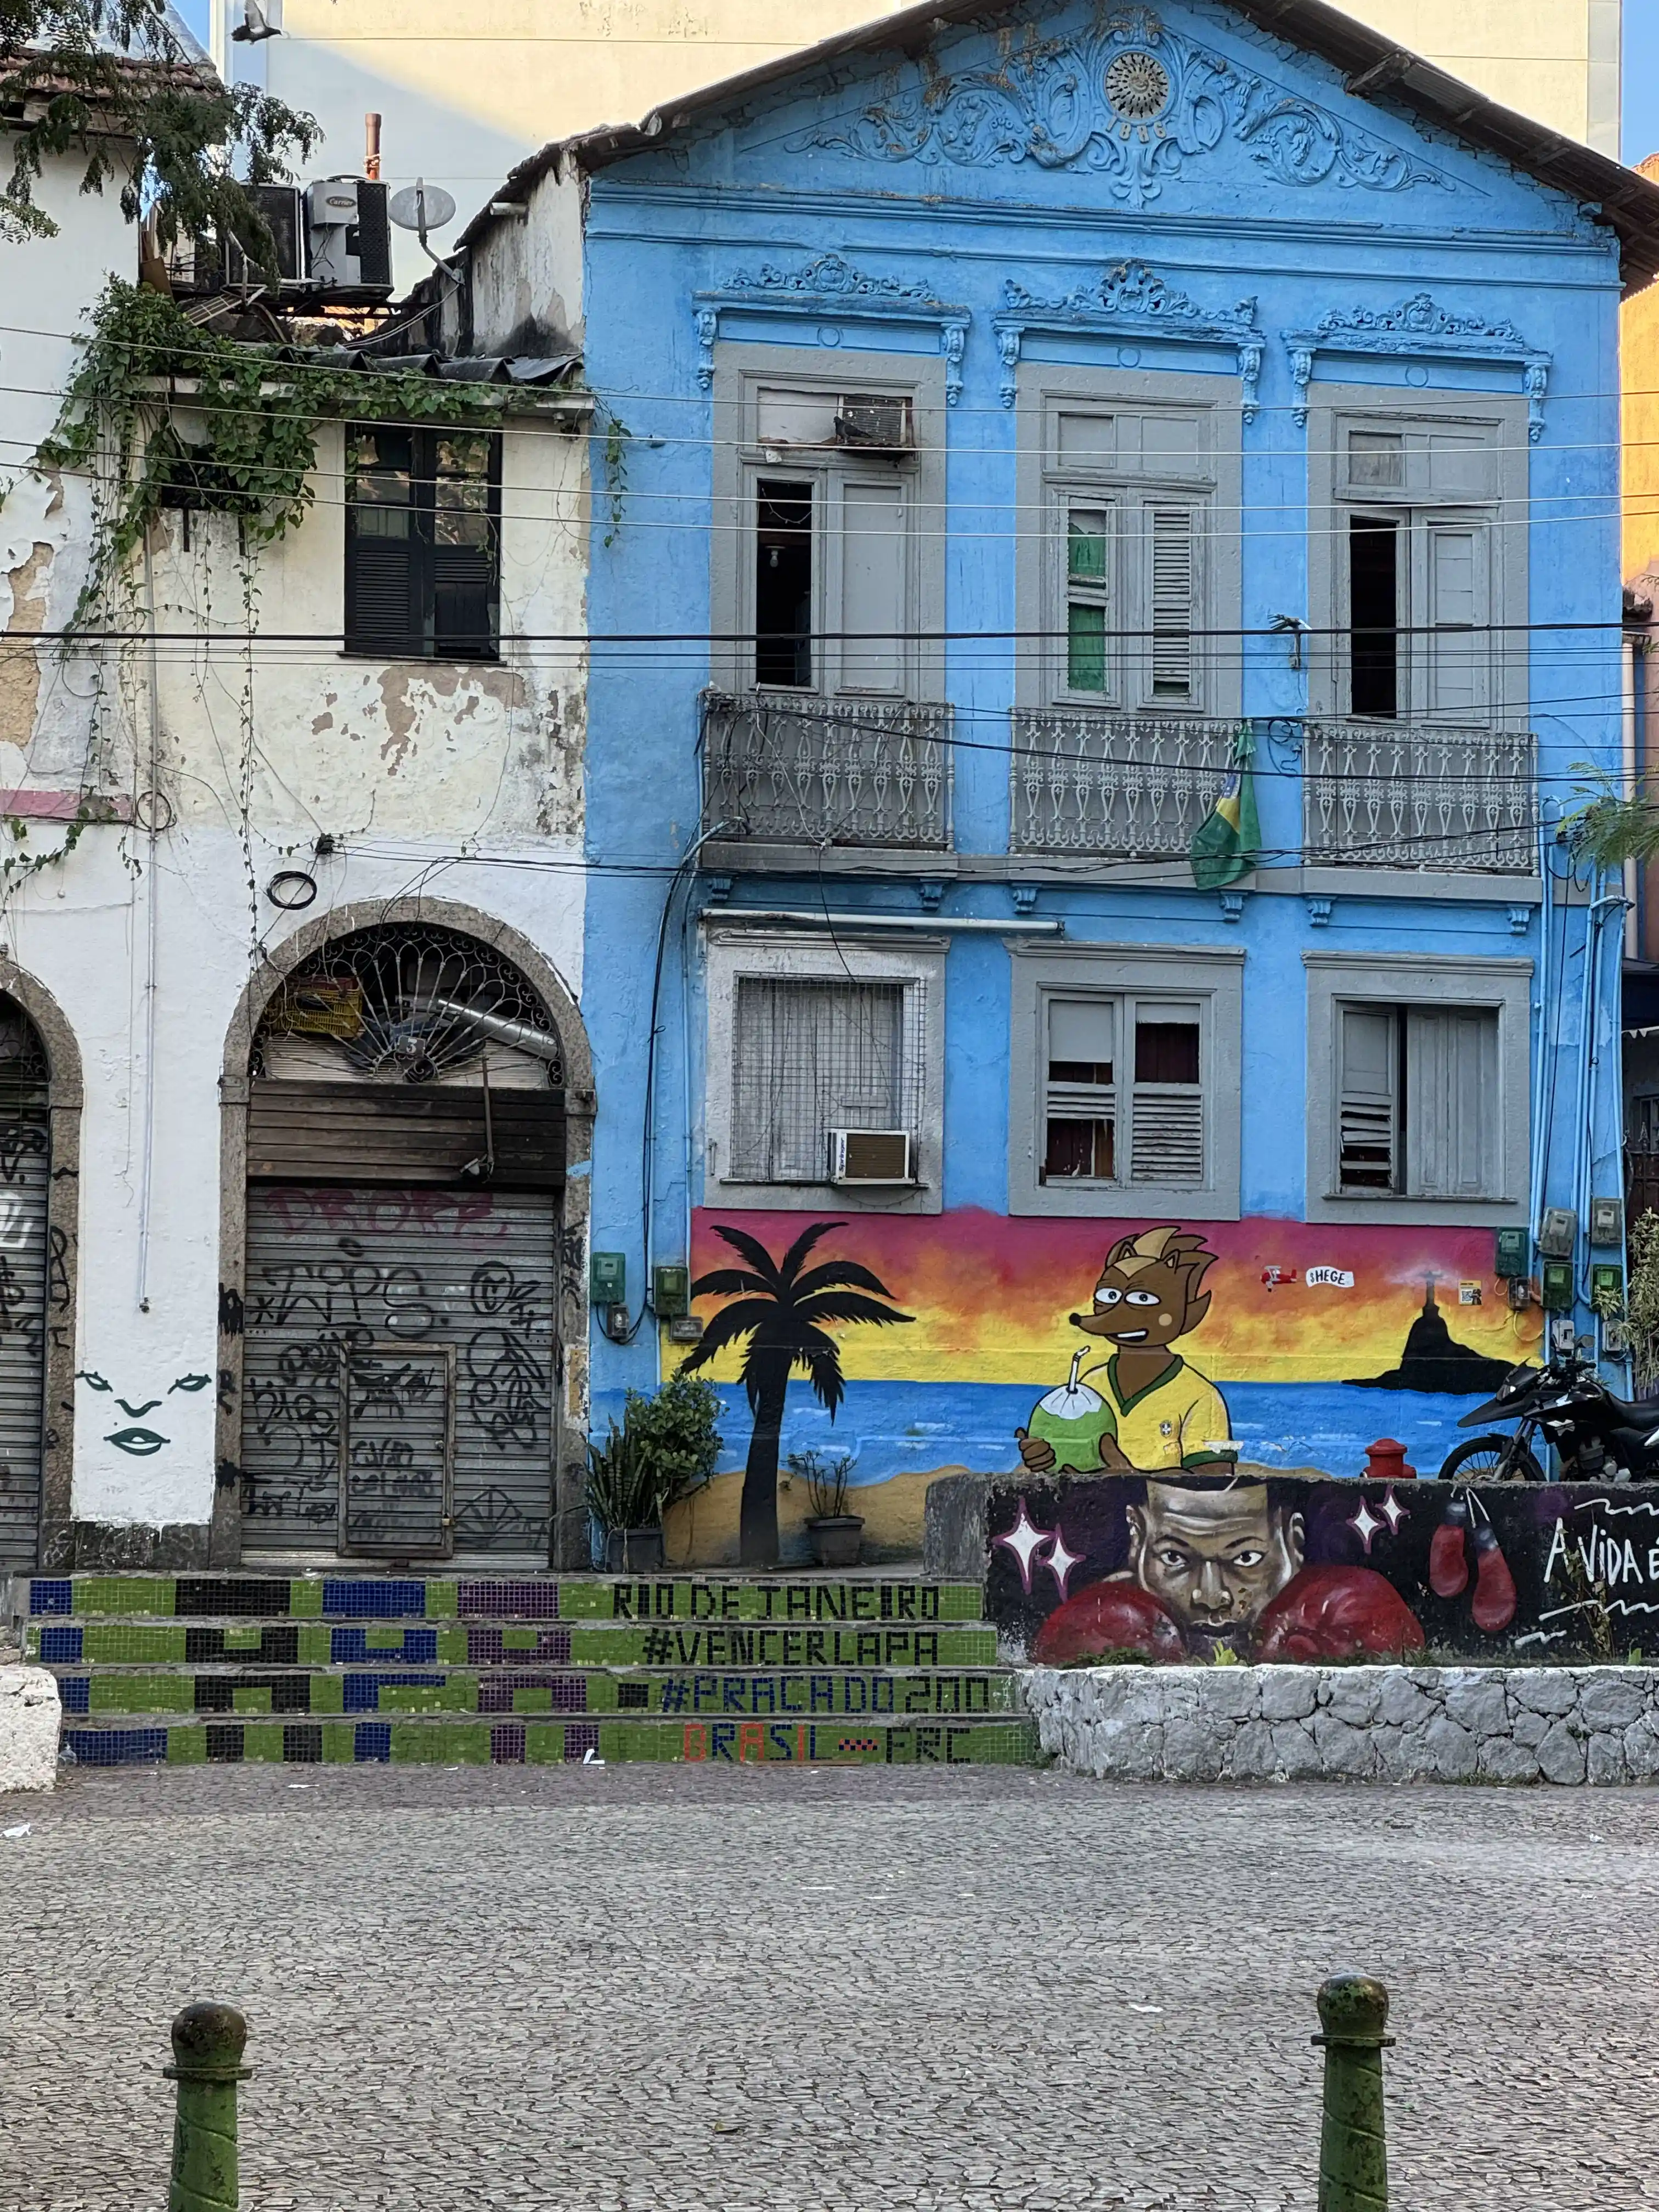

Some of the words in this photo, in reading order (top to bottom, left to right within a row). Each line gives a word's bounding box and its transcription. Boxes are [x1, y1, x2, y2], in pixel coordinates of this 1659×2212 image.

[329, 198, 354, 206] Carrier
[407, 1037, 417, 1054] 3
[1544, 1517, 1570, 1583] A
[613, 1583, 674, 1619] RIO
[691, 1584, 739, 1620] DE
[758, 1585, 939, 1620] JANEIRO
[642, 1628, 938, 1665] #VENCERLAPA
[684, 1723, 833, 1762] BRASIL
